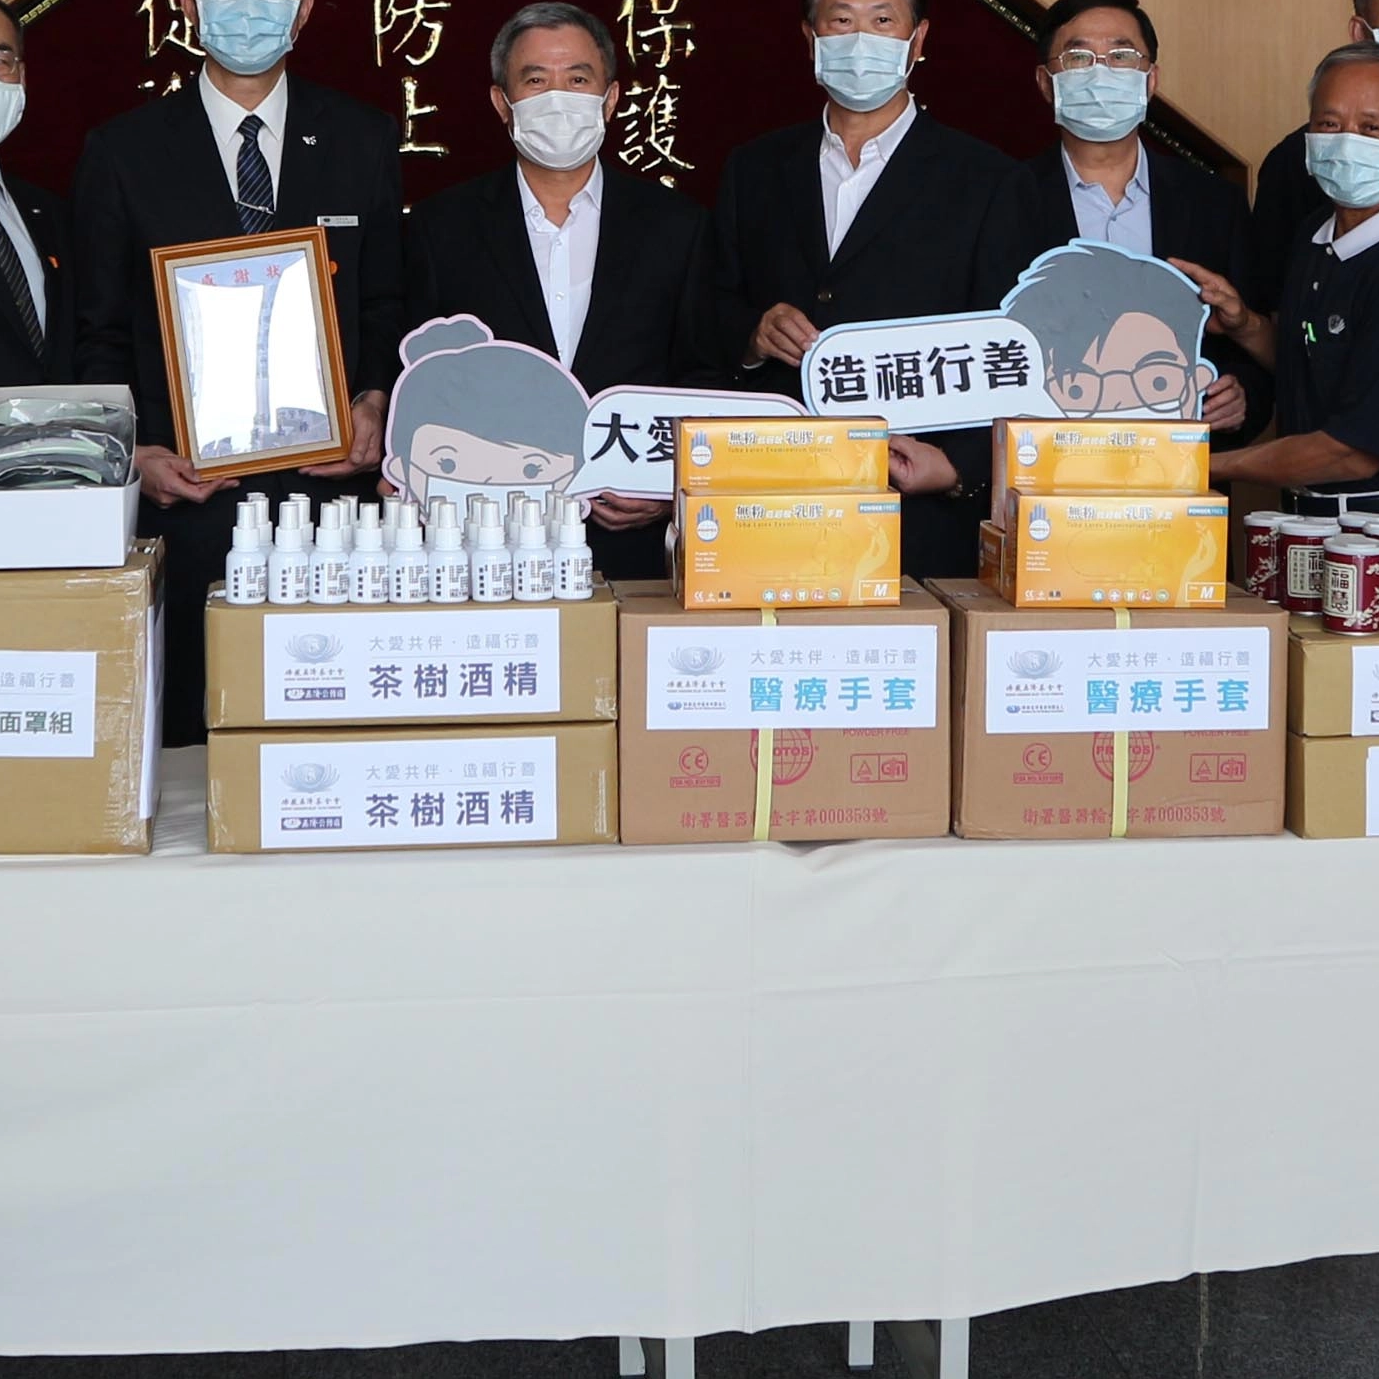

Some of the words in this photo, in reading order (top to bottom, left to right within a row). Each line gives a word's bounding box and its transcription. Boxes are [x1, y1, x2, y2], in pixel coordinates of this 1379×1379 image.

[818, 338, 1031, 405] 造福行善
[874, 584, 890, 597] M
[1200, 587, 1215, 599] M
[368, 661, 539, 700] 茶樹酒精
[749, 677, 916, 712] 醫療手套
[1086, 679, 1250, 716] 醫療手套
[755, 747, 810, 757] OTOS
[365, 789, 535, 828] 茶樹酒精
